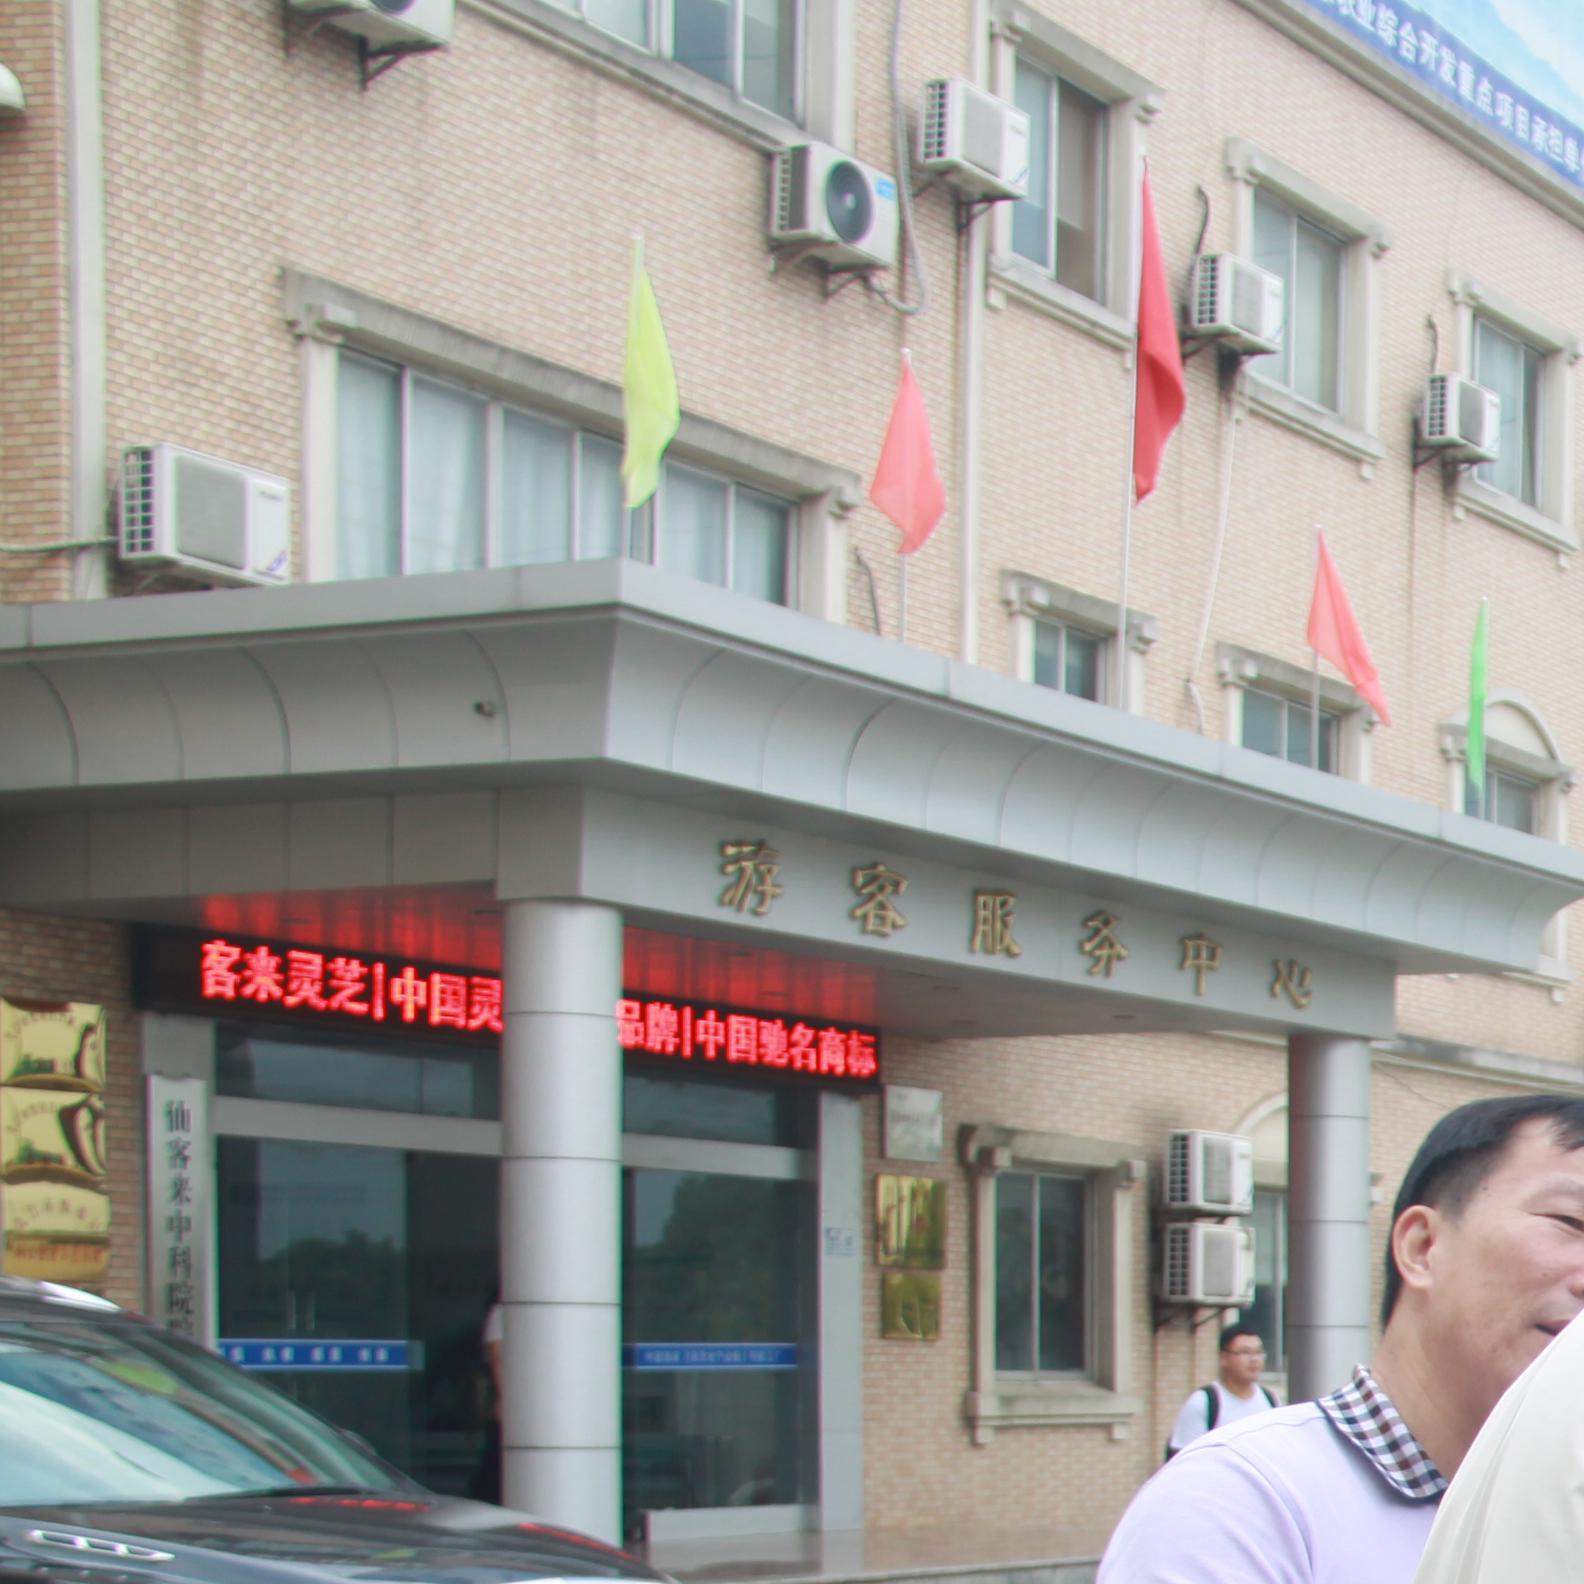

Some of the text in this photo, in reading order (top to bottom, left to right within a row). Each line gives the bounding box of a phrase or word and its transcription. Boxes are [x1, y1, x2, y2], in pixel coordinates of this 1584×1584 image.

[718, 839, 1313, 1008] 游客服务中心
